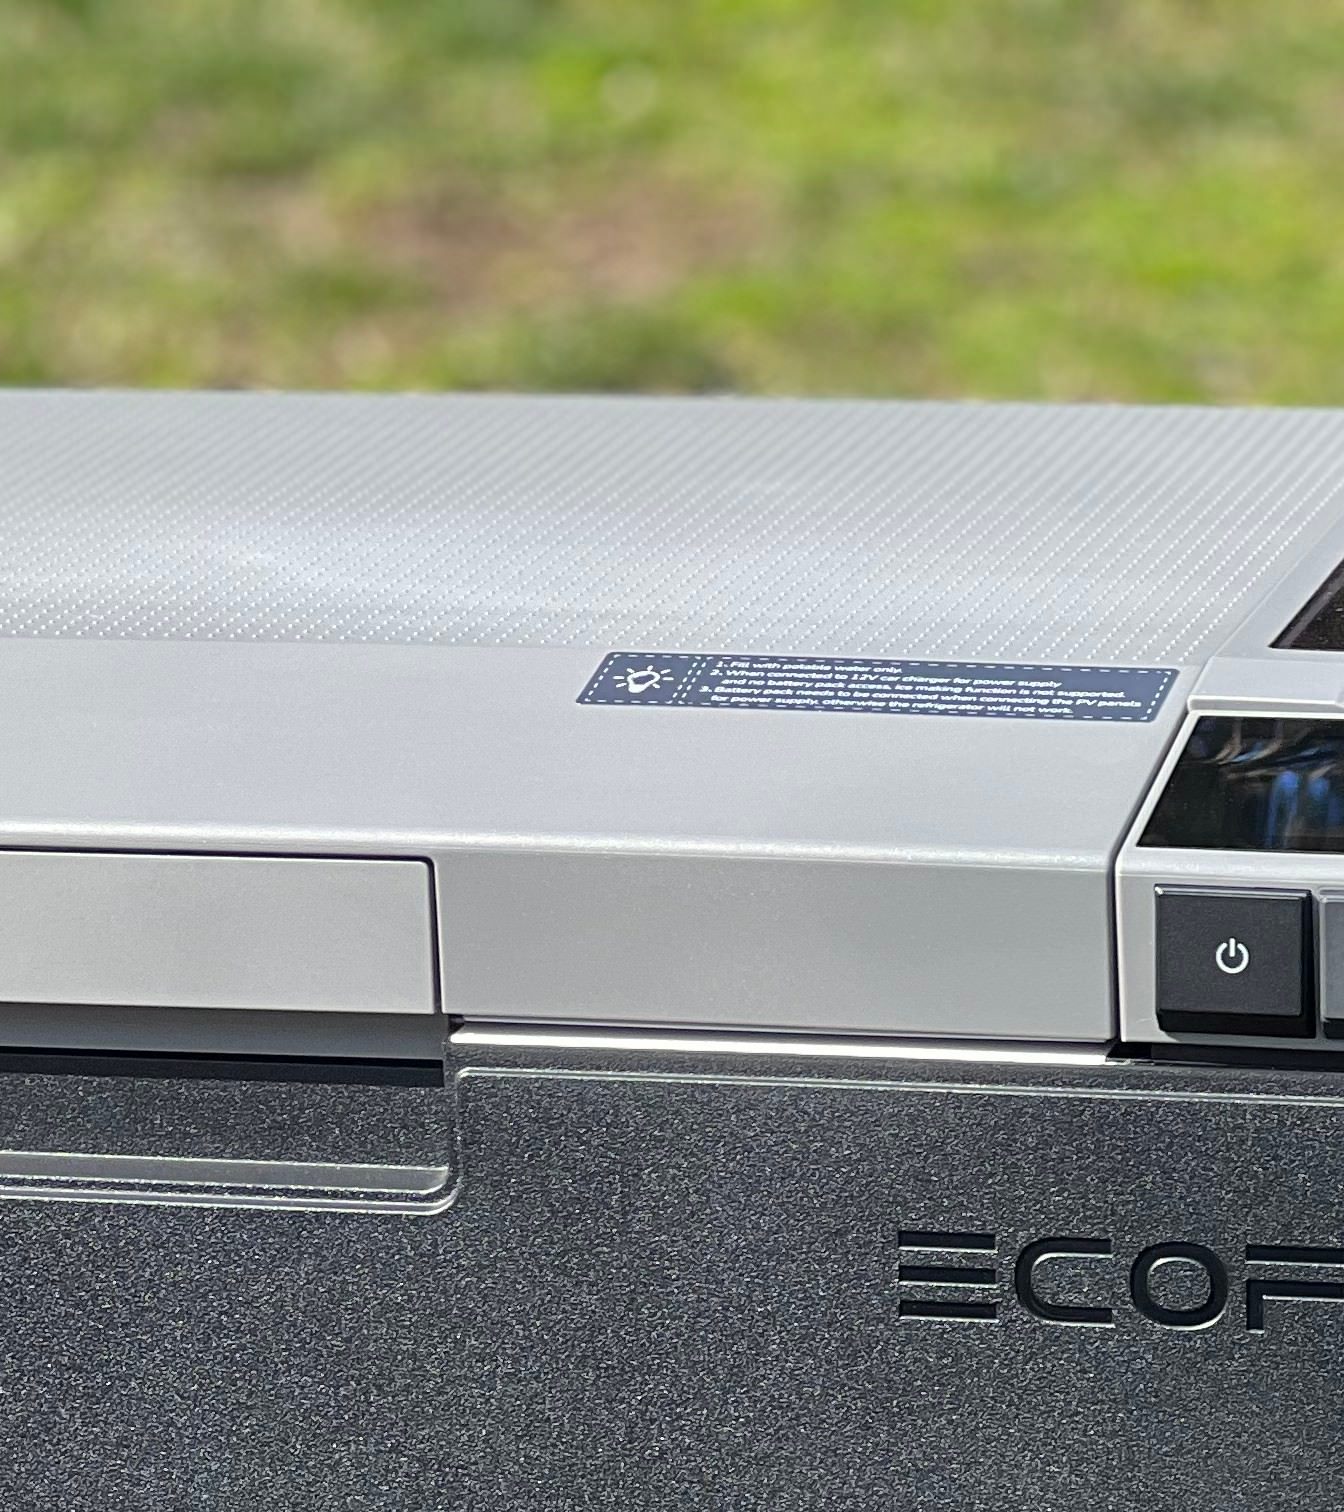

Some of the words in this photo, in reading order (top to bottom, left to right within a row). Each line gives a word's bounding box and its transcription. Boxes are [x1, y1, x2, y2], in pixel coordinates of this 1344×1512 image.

[767, 671, 833, 679] connected
[851, 673, 880, 681] 12V
[902, 675, 952, 684] charger
[1018, 680, 1063, 688] supply
[767, 680, 814, 688] battery
[915, 685, 963, 693] making
[965, 686, 1017, 694] function
[714, 686, 762, 695] Battery
[872, 692, 939, 700] connected
[941, 694, 977, 702] when
[980, 696, 1050, 705] connecting
[1098, 700, 1142, 708] panels
[822, 699, 887, 707] otherwise
[912, 702, 985, 710] refrigerator
[987, 704, 1011, 712] will
